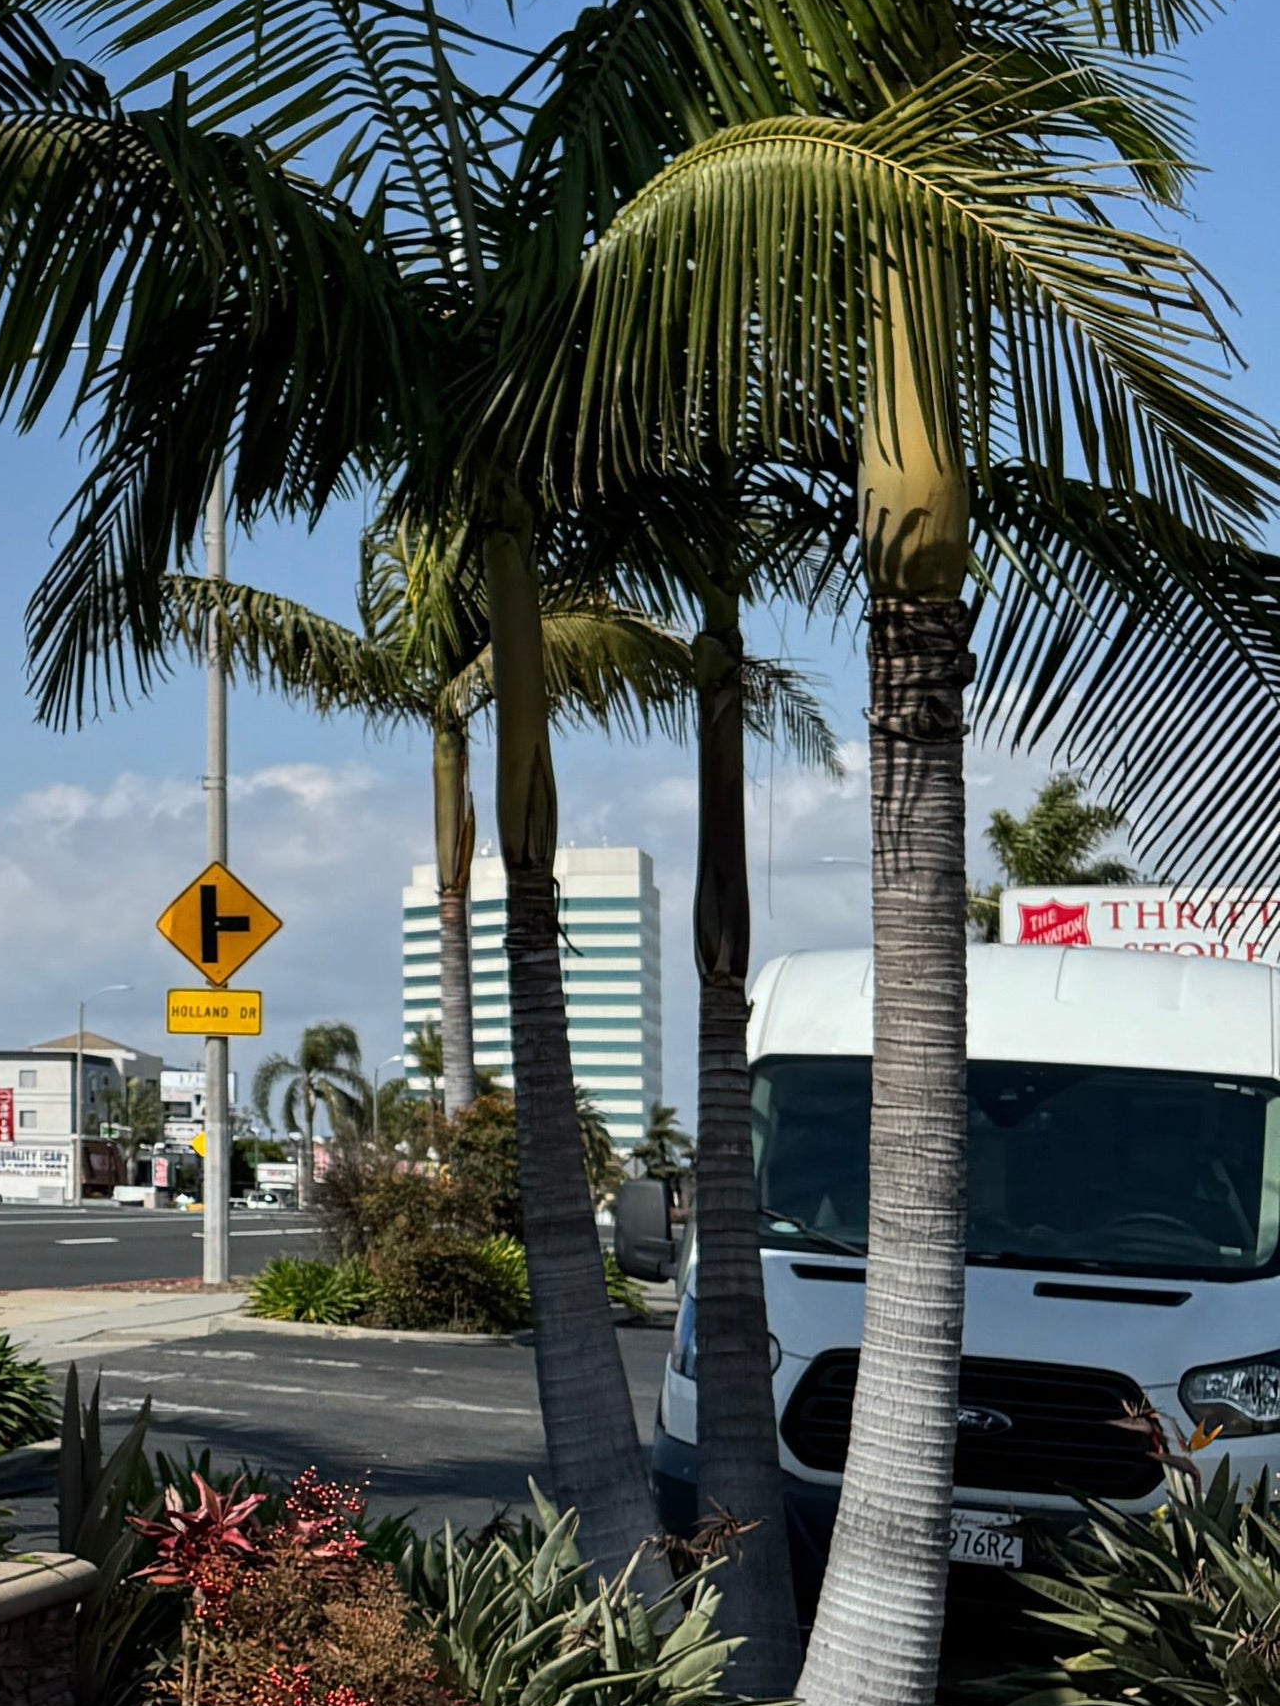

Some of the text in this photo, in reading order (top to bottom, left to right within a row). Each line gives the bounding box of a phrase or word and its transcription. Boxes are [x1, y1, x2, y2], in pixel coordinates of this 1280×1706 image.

[1028, 908, 1057, 932] THE
[1101, 899, 1280, 931] THRIFT
[171, 1005, 257, 1019] HOLLAND DR
